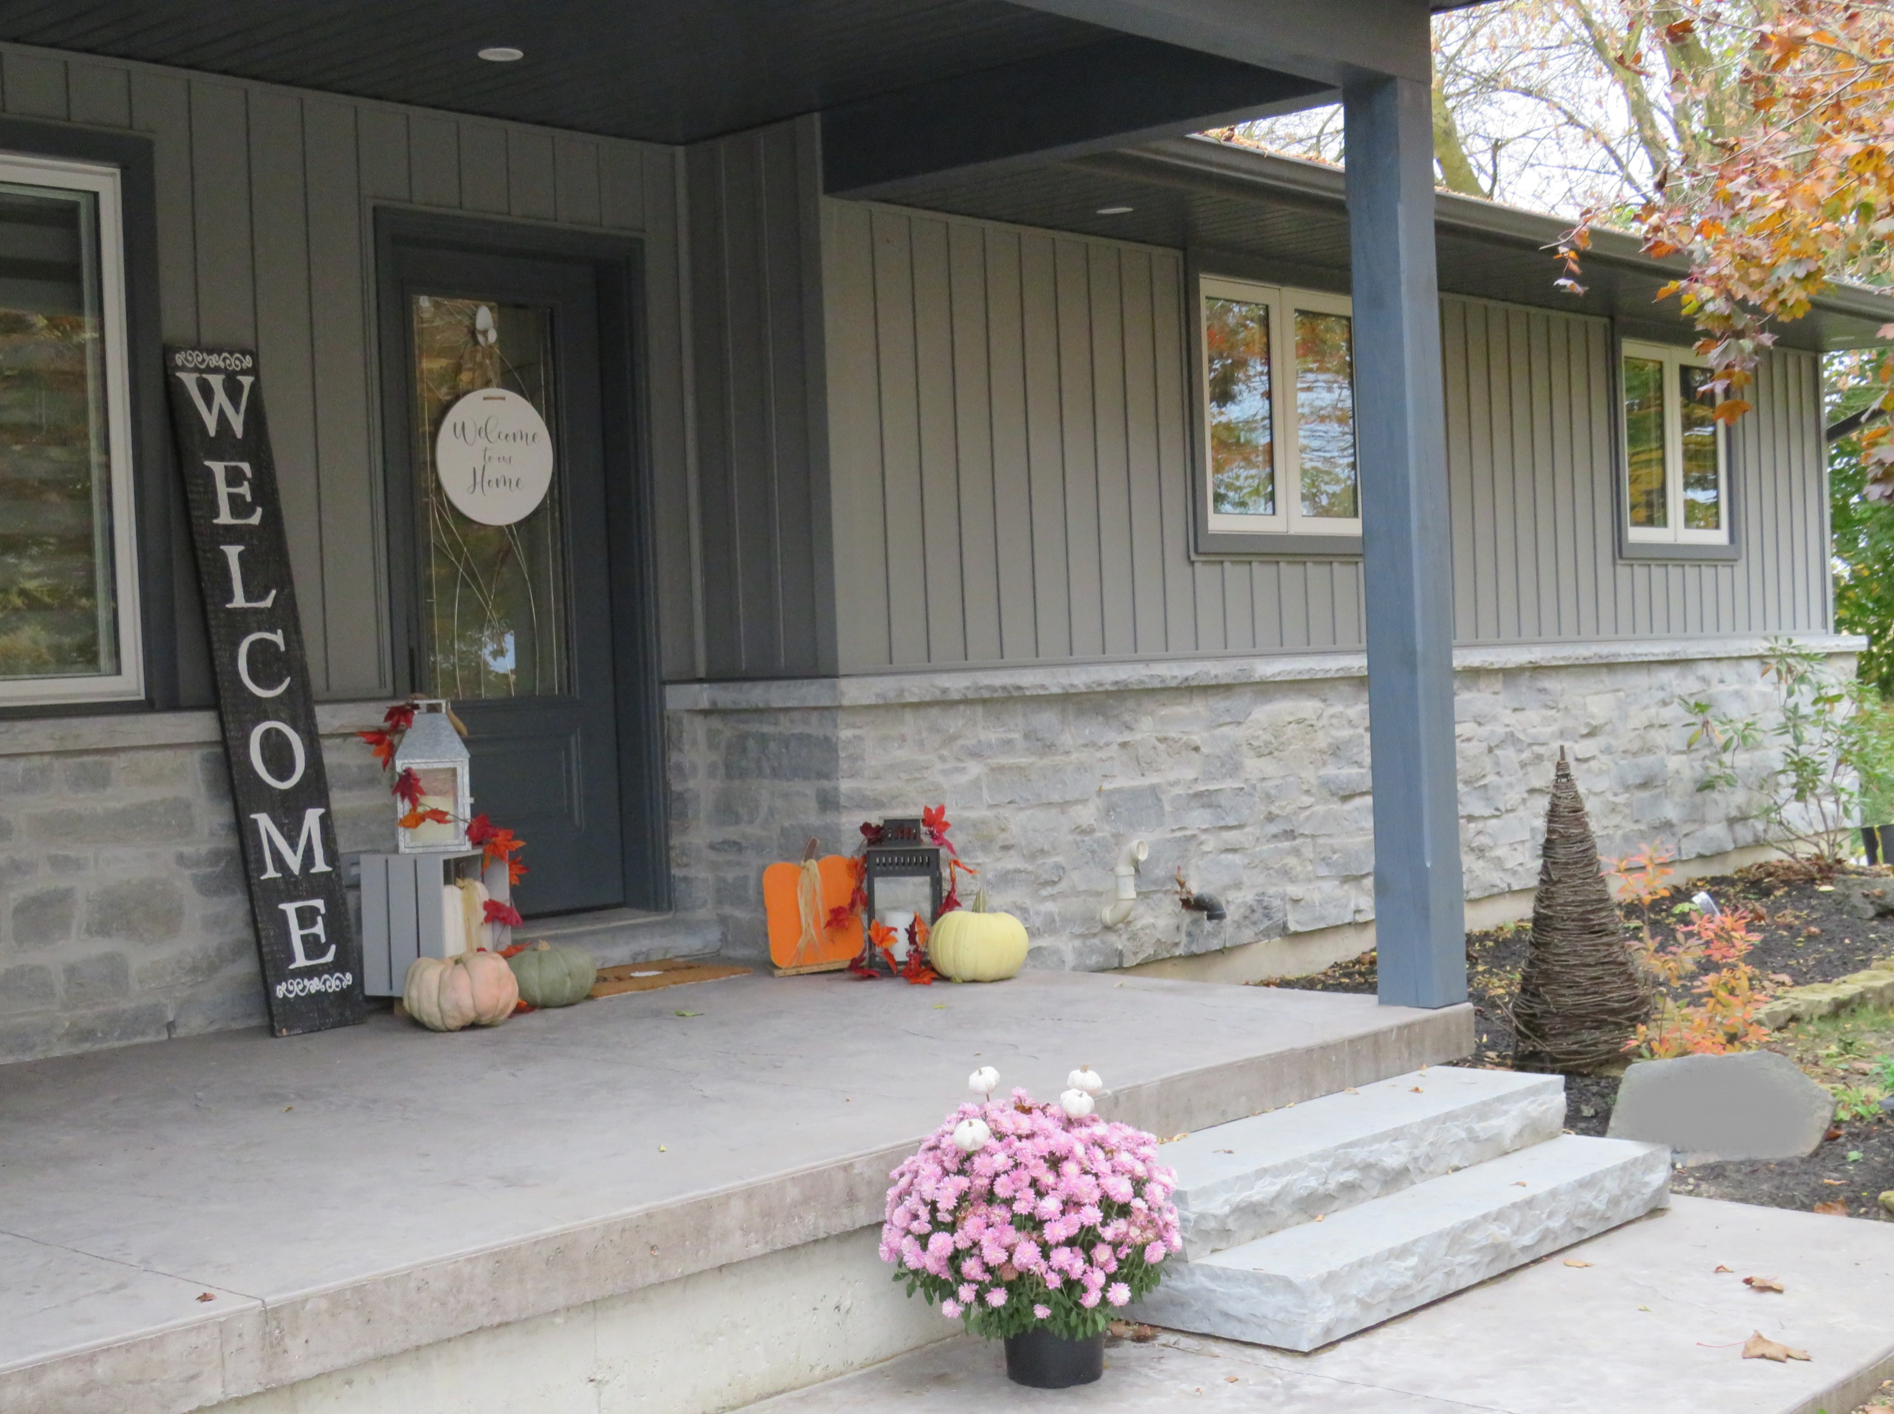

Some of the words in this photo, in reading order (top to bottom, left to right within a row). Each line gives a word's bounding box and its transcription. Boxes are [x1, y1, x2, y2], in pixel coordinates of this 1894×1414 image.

[453, 416, 539, 446] Welcome
[483, 446, 493, 464] to
[497, 455, 513, 465] our
[467, 464, 525, 496] Home
[176, 371, 337, 970] WELCOME
